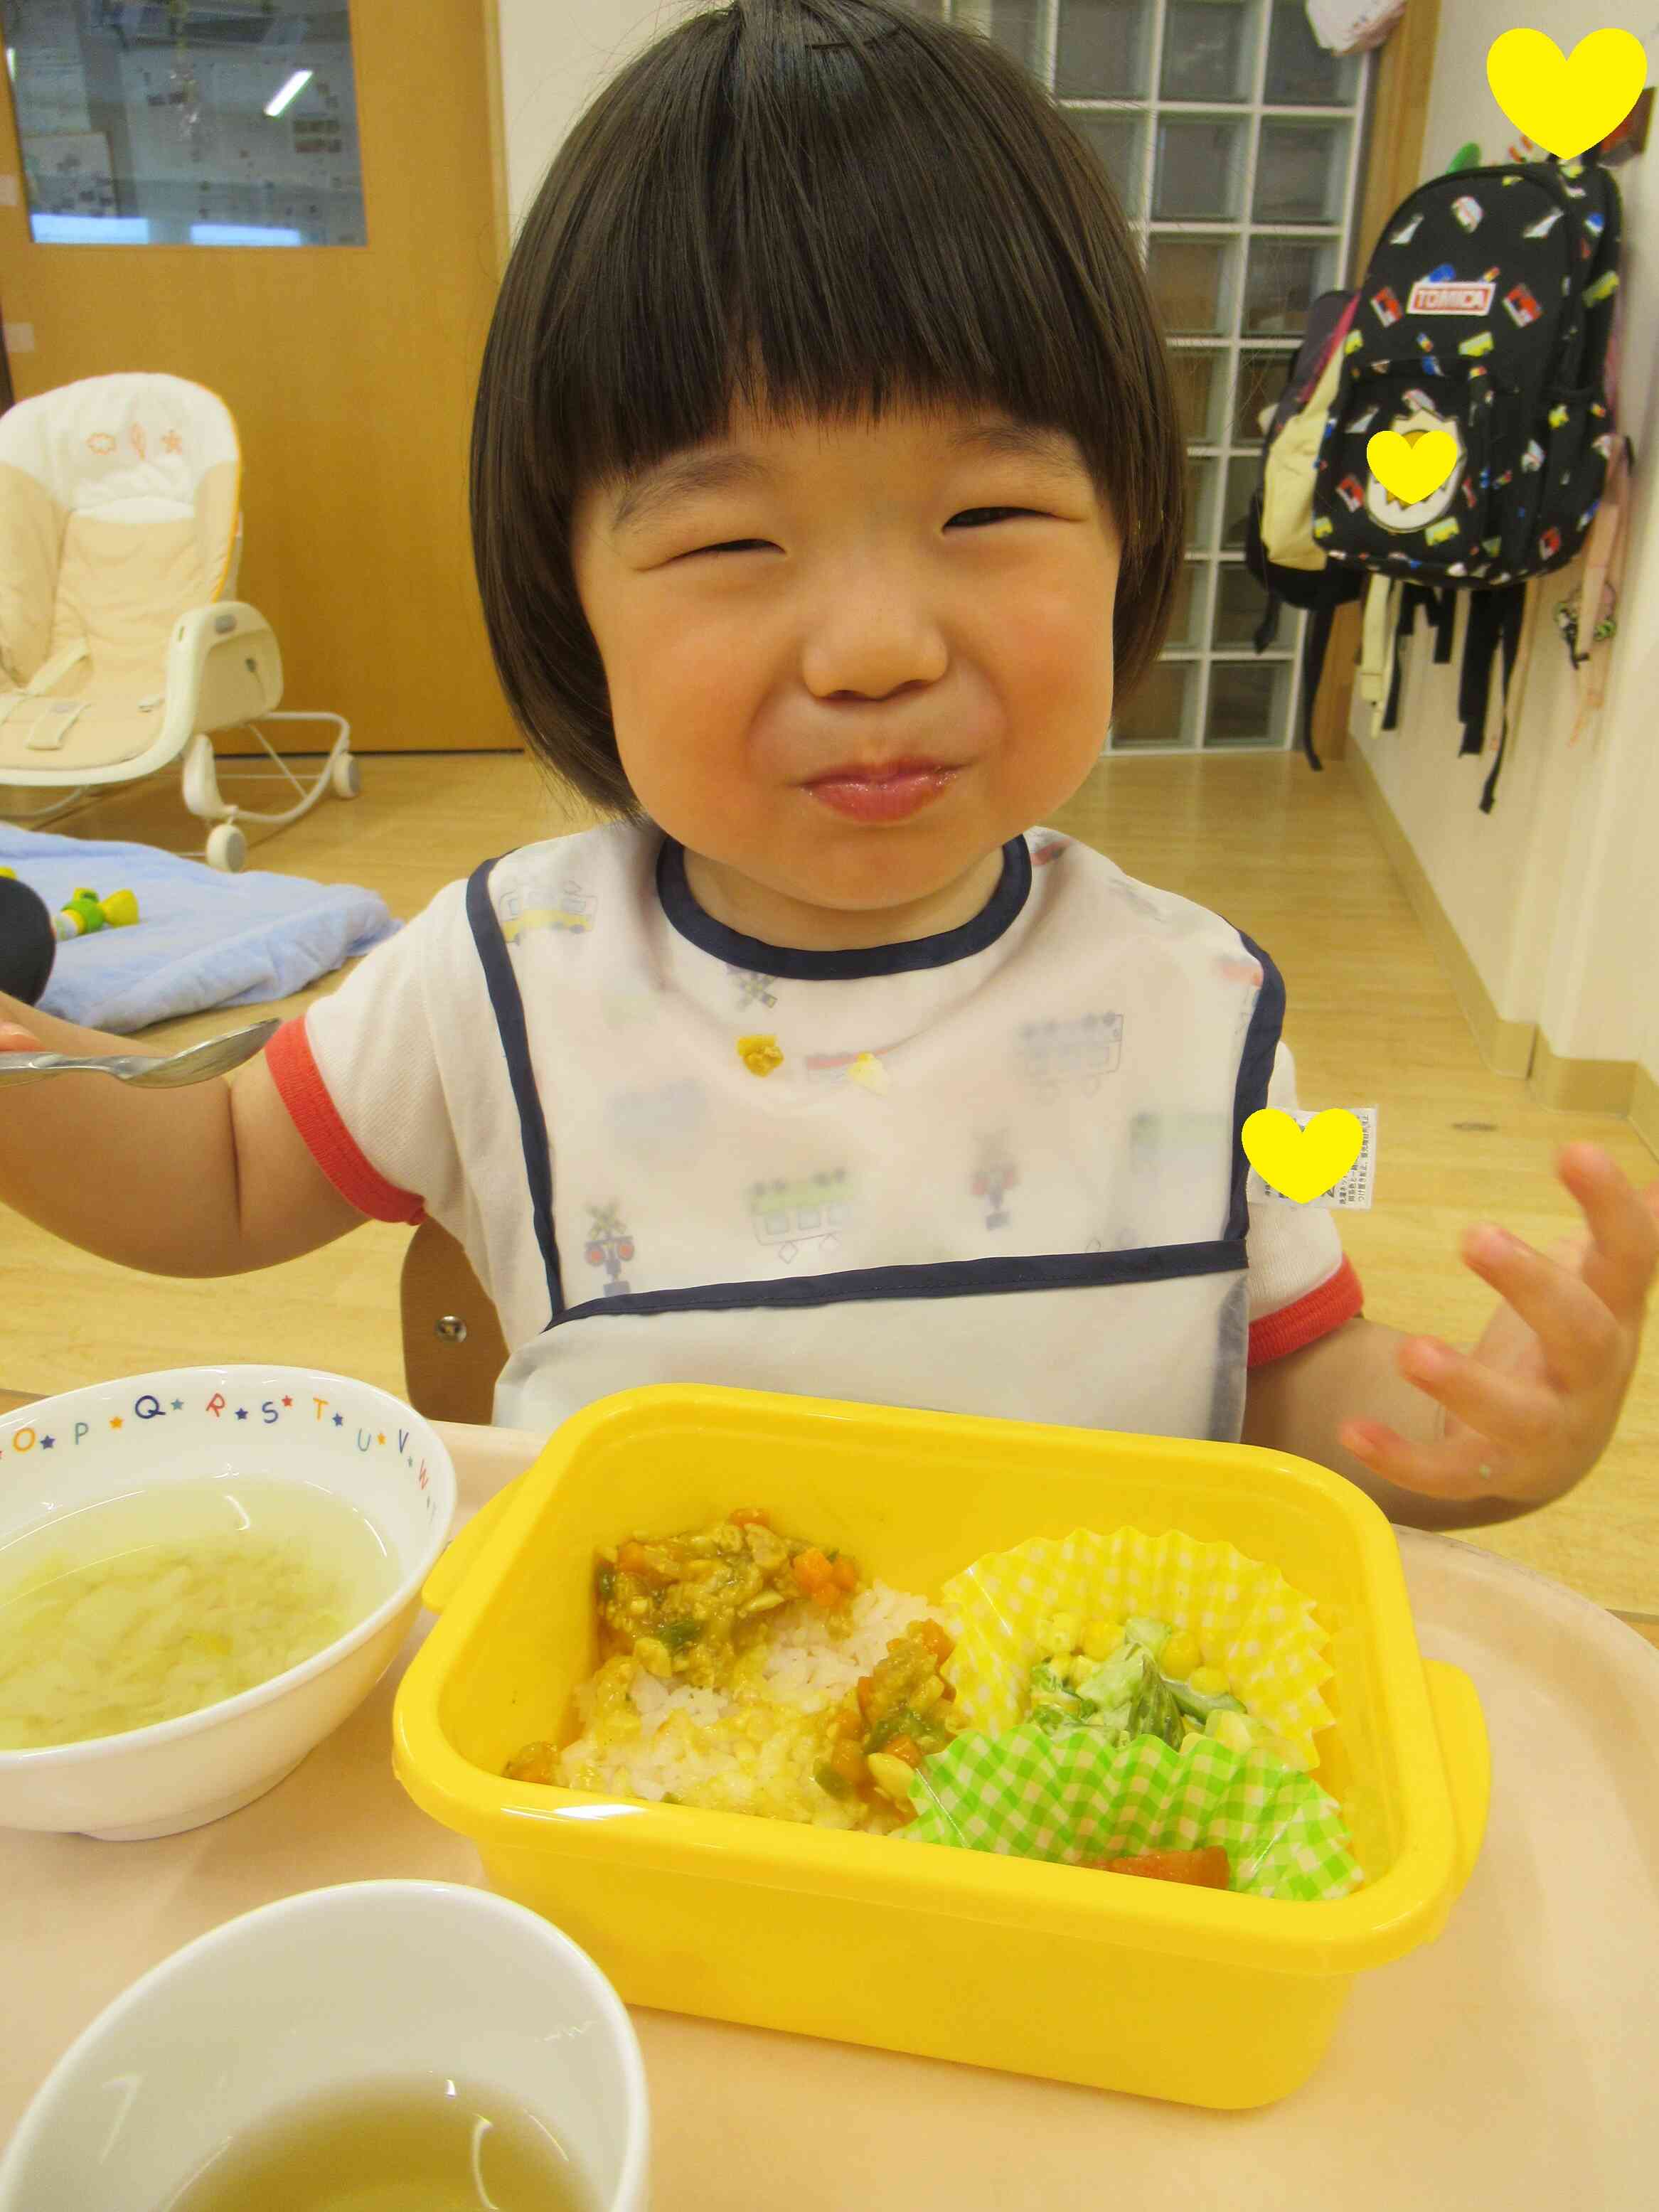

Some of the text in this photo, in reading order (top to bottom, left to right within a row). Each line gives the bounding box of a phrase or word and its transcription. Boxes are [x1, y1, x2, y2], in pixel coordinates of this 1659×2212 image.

[1414, 289, 1485, 309] TOMICA
[12, 1427, 36, 1453] O
[75, 1421, 89, 1446] P
[134, 1394, 166, 1419] Q
[205, 1392, 226, 1418] R
[261, 1401, 279, 1423] S
[312, 1397, 329, 1421] T
[357, 1427, 372, 1452] U
[398, 1428, 410, 1453] V
